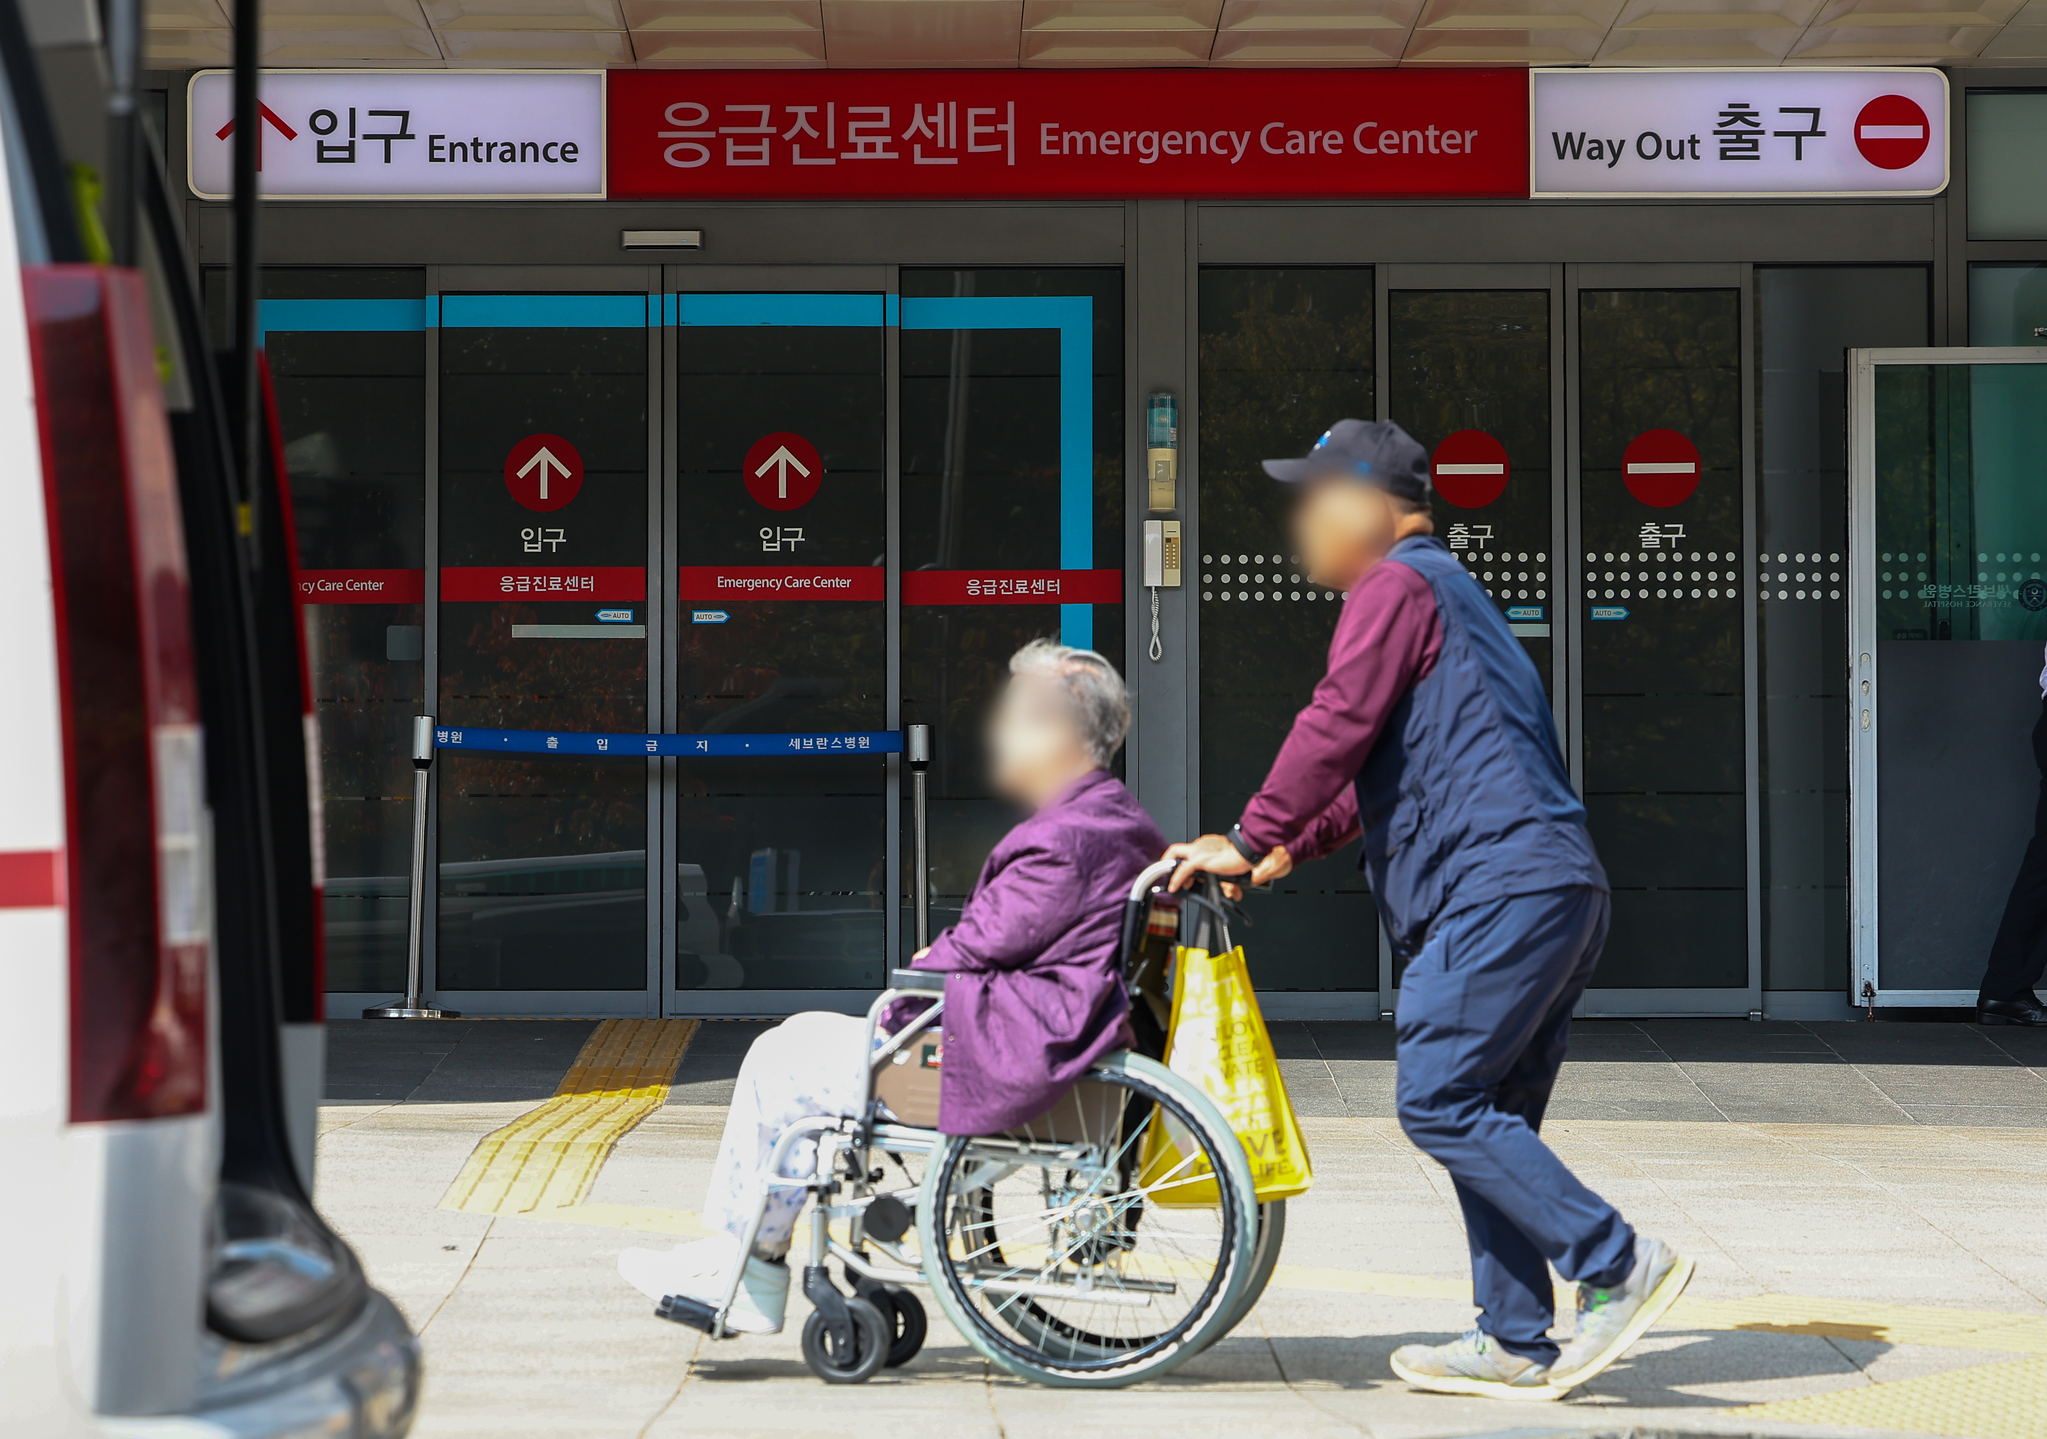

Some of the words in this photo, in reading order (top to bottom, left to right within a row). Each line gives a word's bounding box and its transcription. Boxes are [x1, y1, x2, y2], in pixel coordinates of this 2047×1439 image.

[309, 107, 416, 164] 입구
[428, 134, 579, 164] Entrance
[657, 100, 1016, 168] 응급진료센터
[1040, 122, 1252, 165] Emergency
[1259, 121, 1345, 155] Care
[1353, 121, 1478, 155] Center
[1551, 131, 1626, 169] Way
[1635, 131, 1701, 161] Out
[1712, 103, 1827, 161] 출구
[520, 527, 567, 553] 입구
[759, 526, 806, 552] 입구
[1447, 523, 1495, 549] 출구
[1638, 522, 1687, 549] 출구
[316, 579, 344, 592] Care
[345, 579, 385, 591] Center
[499, 575, 595, 593] 응급진료센터
[717, 575, 783, 591] Emergency
[784, 575, 812, 588] Care
[812, 575, 852, 588] Center
[966, 578, 1062, 596] 응급진료센터
[612, 612, 630, 620] AUTO
[695, 613, 713, 621] AUTO
[1522, 609, 1540, 617] AUTO
[1594, 609, 1612, 617] AUTO
[437, 730, 463, 744] 병원
[788, 736, 870, 750] 세브란스병원
